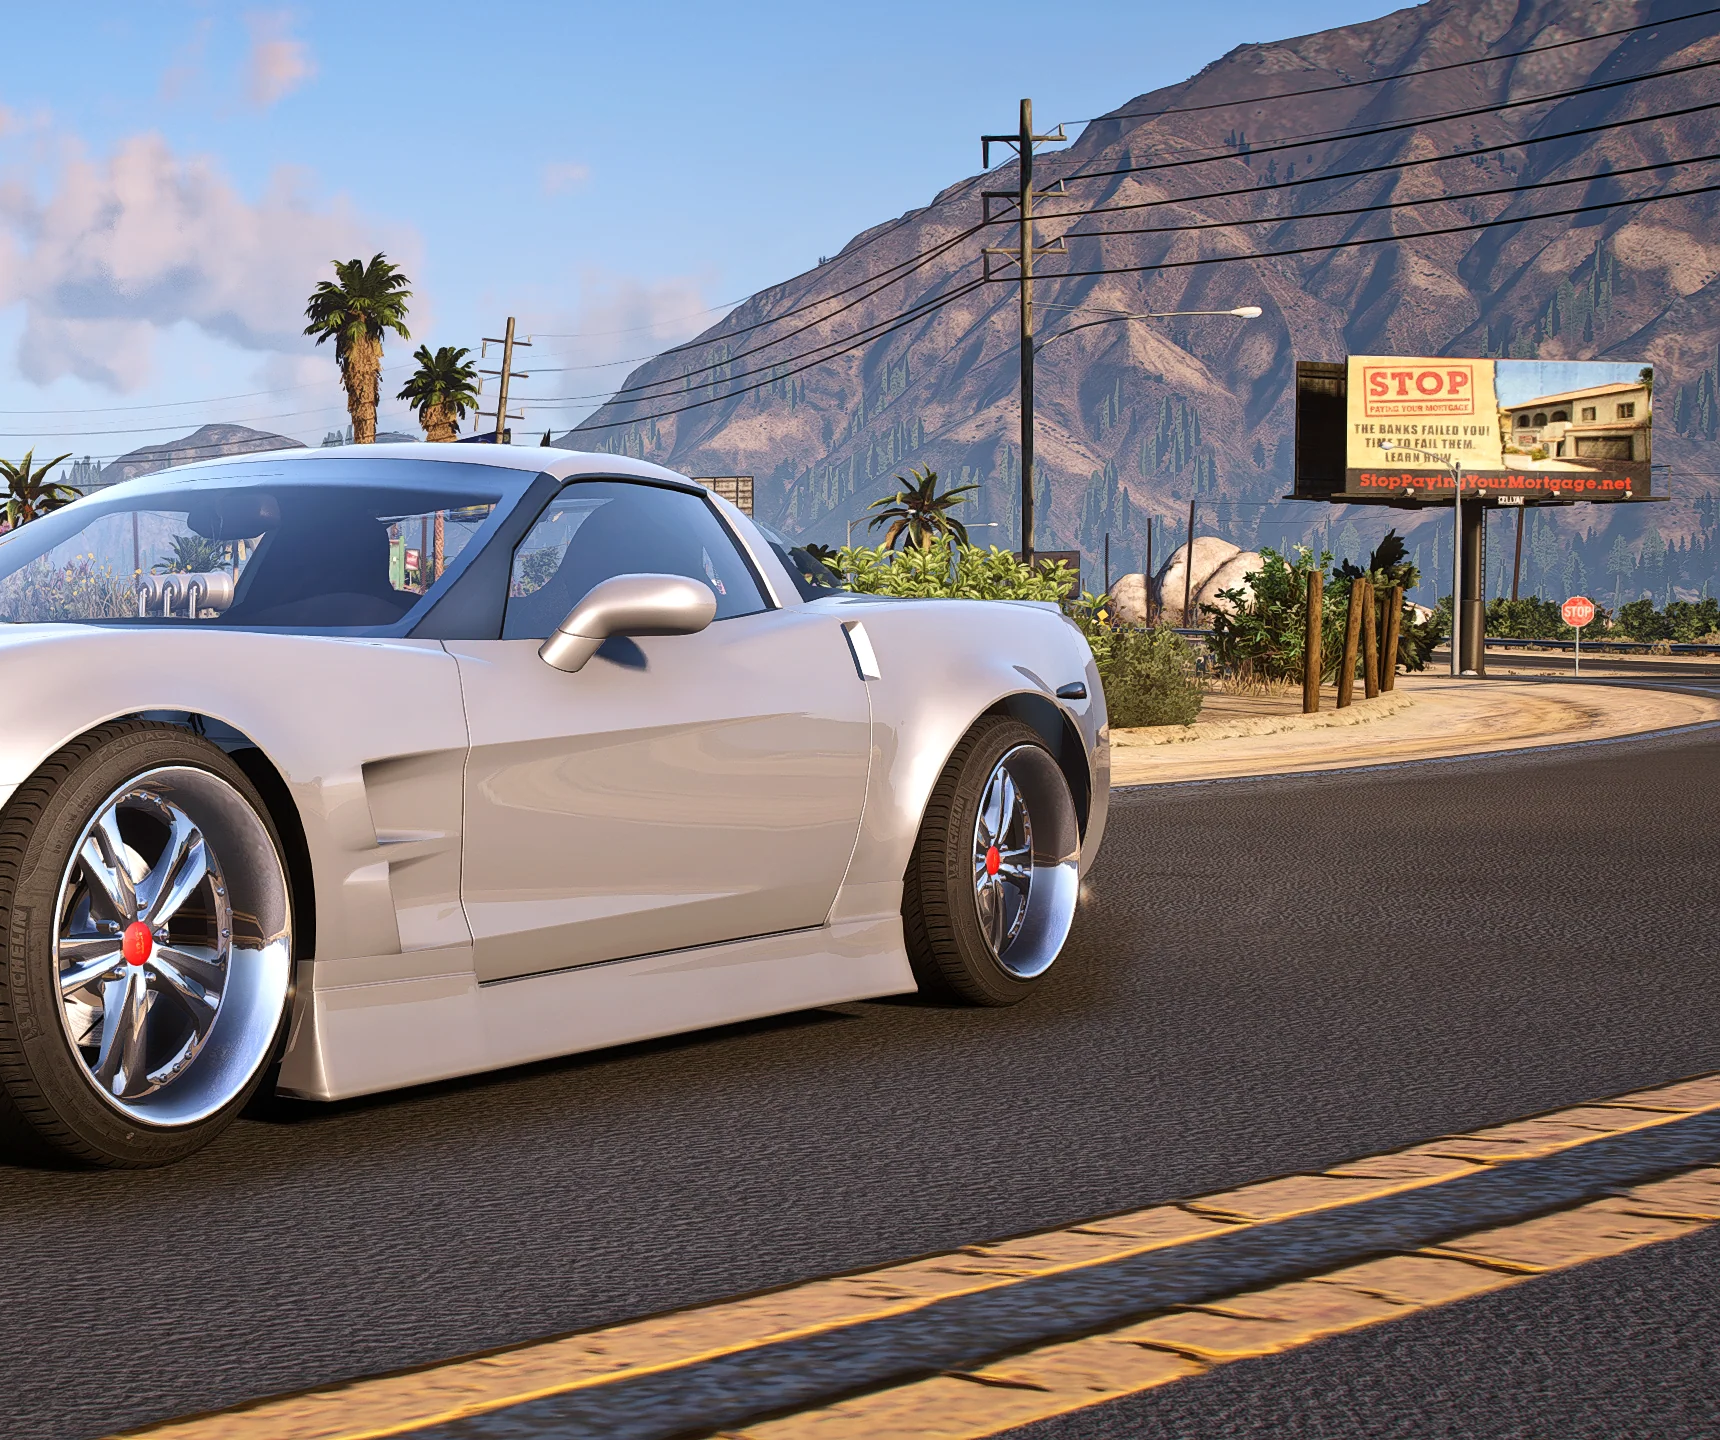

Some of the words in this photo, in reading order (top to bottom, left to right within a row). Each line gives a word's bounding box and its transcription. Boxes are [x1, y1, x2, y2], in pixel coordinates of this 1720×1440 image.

[1370, 371, 1469, 397] STOP
[1401, 404, 1423, 413] YOUR
[1425, 404, 1469, 412] MORTGAGE
[1354, 424, 1375, 434] THE
[1379, 424, 1418, 435] BANKS
[1421, 425, 1459, 436] FAILED
[1463, 425, 1490, 436] YOU!
[1396, 438, 1411, 449] TO
[1415, 439, 1438, 449] FAIL
[1441, 439, 1476, 450] THEM.
[1385, 452, 1420, 463] LEARN
[1564, 606, 1592, 617] STOP
[948, 796, 965, 862] MICHELIN
[11, 909, 30, 1014] MICHELIN
